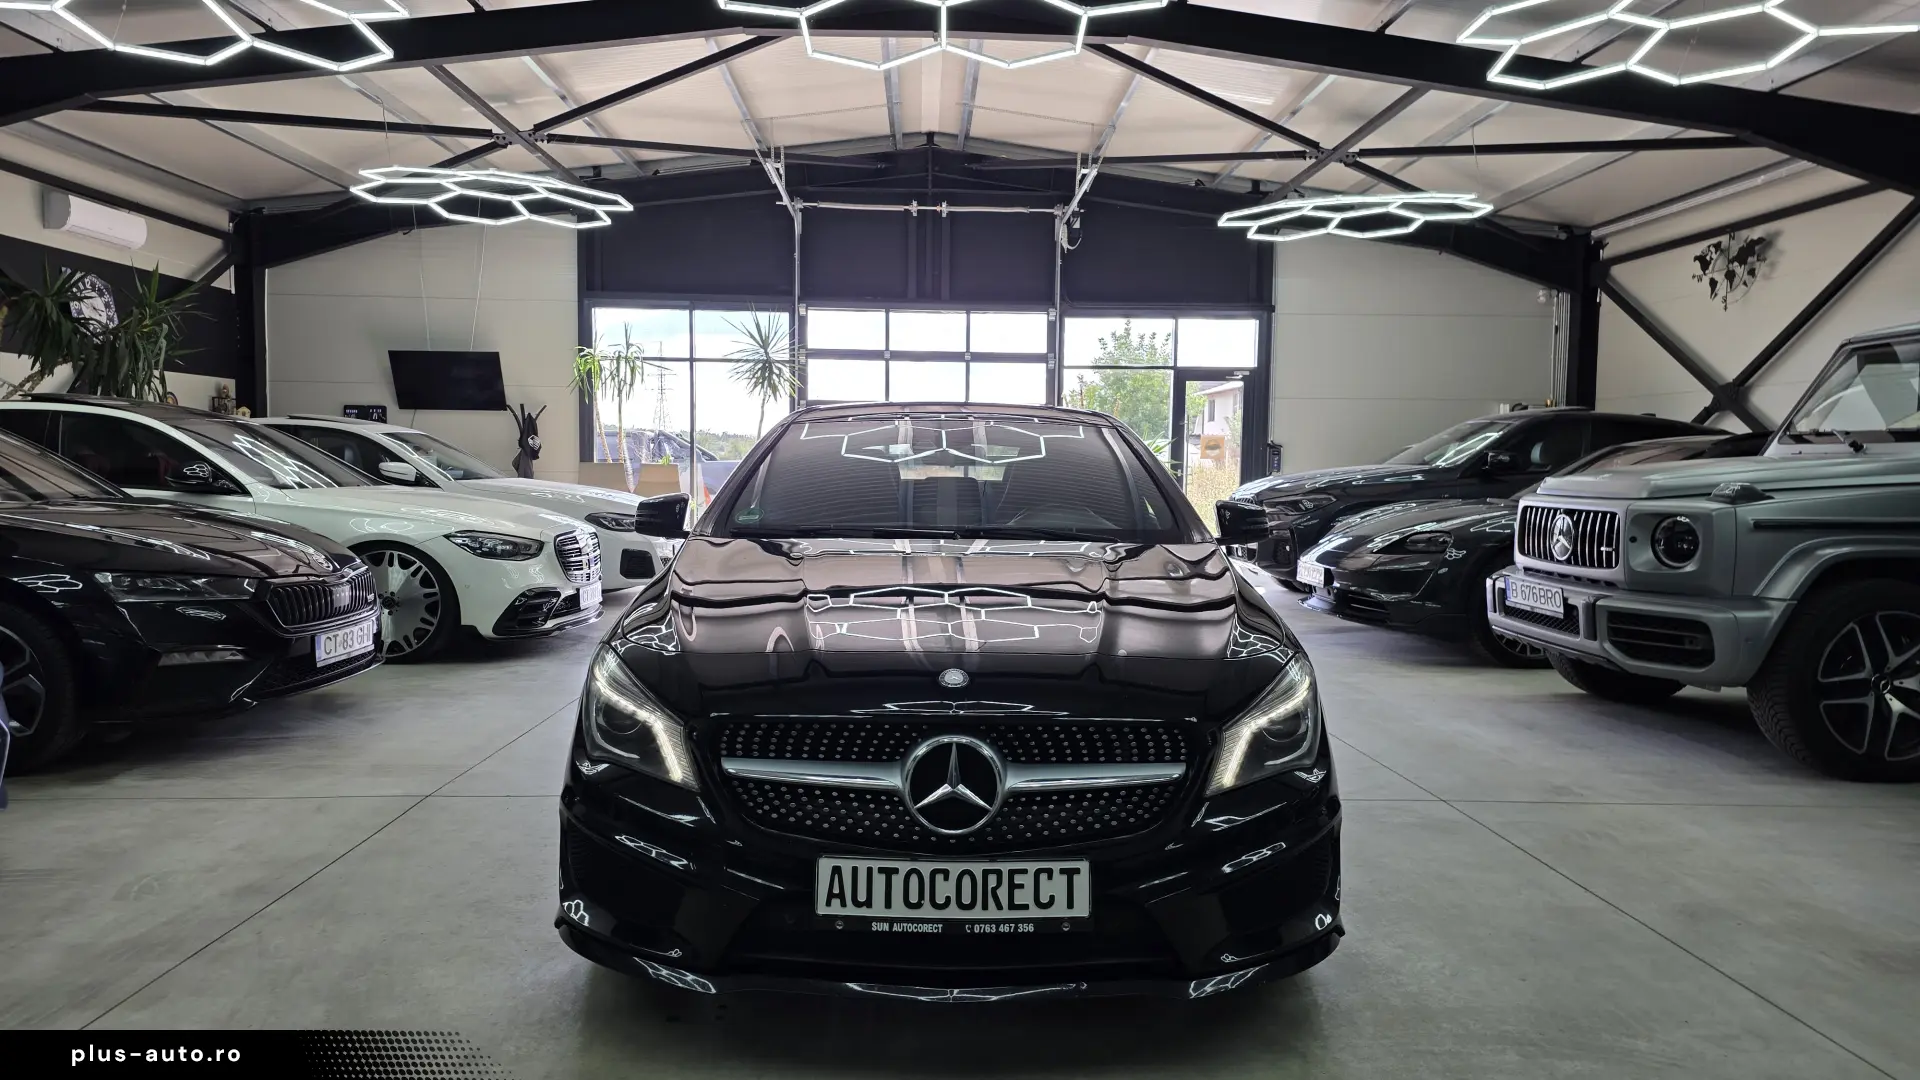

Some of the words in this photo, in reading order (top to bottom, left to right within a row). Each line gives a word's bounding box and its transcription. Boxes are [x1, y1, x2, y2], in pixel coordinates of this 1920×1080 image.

[1510, 581, 1518, 599] B
[324, 633, 339, 655] CT
[342, 629, 355, 650] 83
[825, 865, 1081, 910] AUTOCORECT
[871, 921, 890, 931] SUN
[892, 922, 943, 933] AUTOCORECT
[974, 924, 996, 933] 0763
[998, 923, 1016, 933] 467
[1017, 923, 1034, 933] 356
